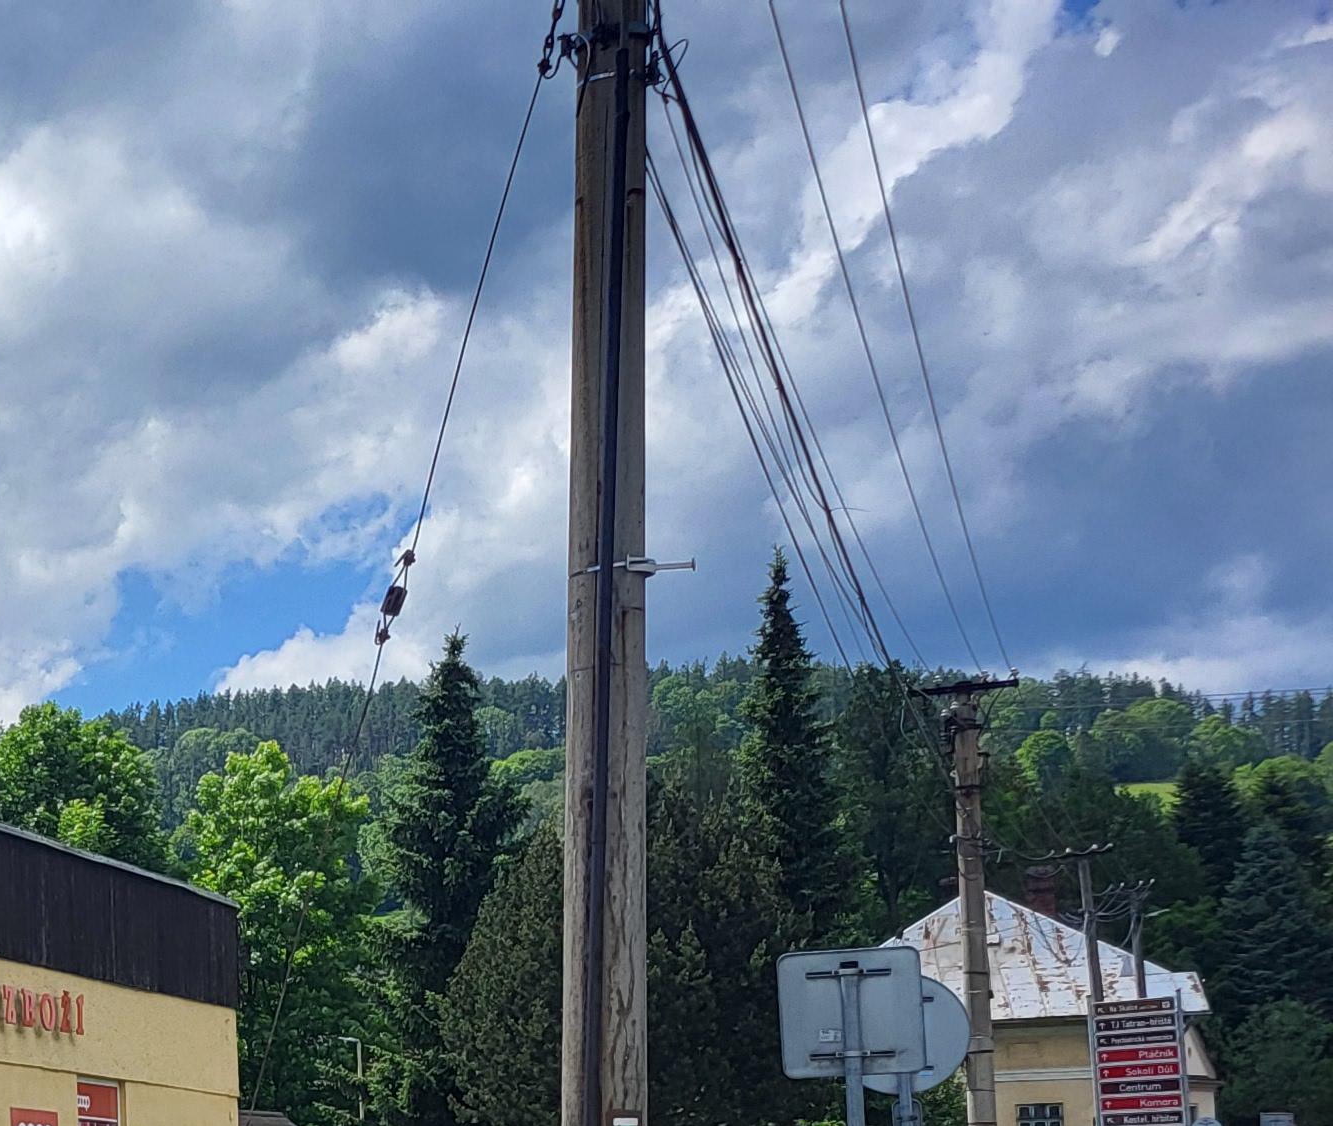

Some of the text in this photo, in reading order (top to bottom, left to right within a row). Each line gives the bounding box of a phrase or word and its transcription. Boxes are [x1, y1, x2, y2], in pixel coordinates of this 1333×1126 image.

[1138, 1048, 1175, 1059] Ptáčník
[1119, 1083, 1162, 1092] Centrum
[1139, 1099, 1179, 1107] Komora
